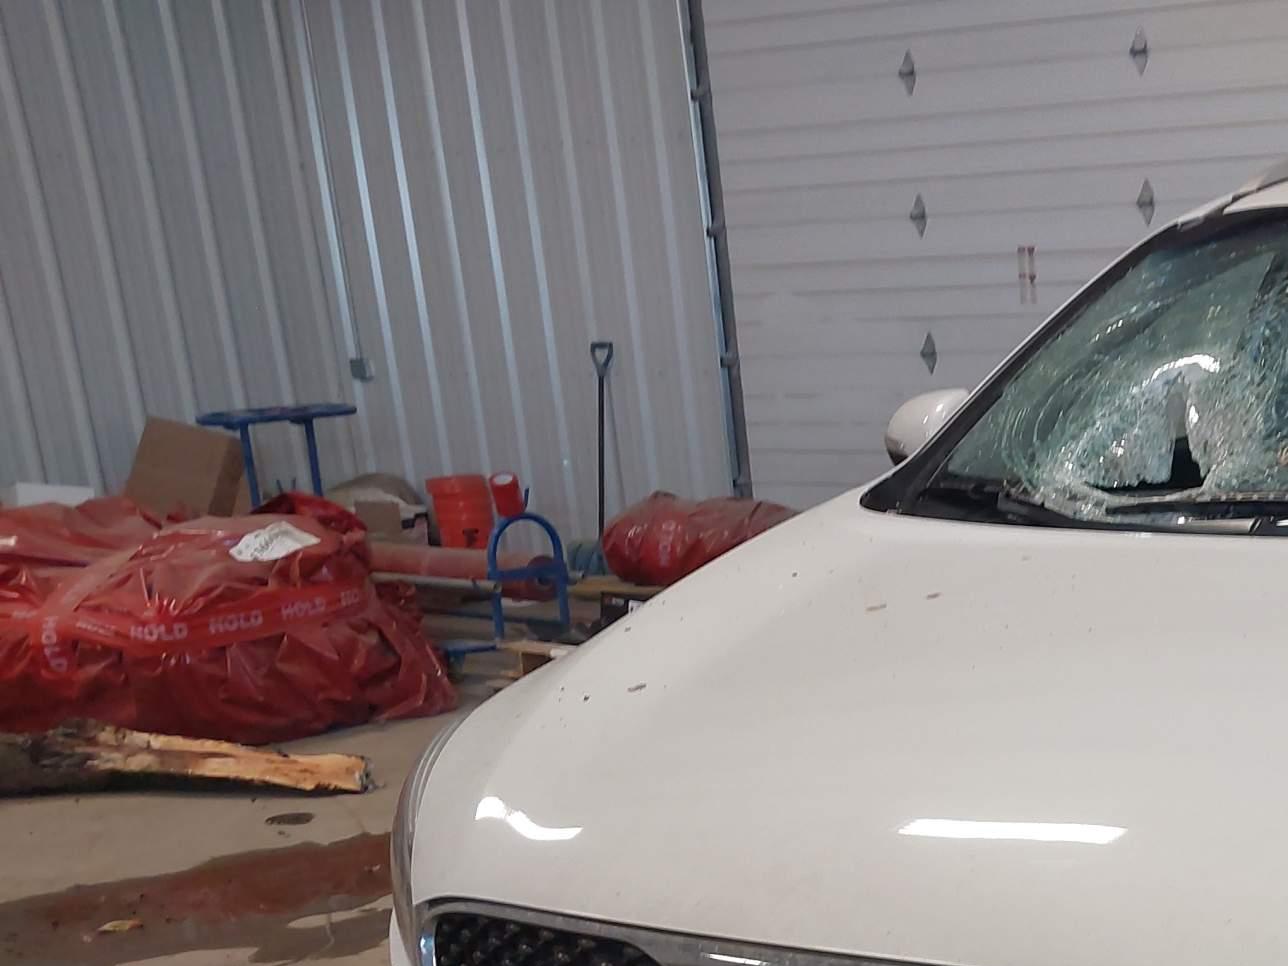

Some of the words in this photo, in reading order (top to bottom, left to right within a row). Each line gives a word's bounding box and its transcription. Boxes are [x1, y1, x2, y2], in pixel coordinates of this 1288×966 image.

[129, 622, 189, 642] HOLD
[208, 609, 264, 635] HOLD
[281, 596, 327, 620] HOLD
